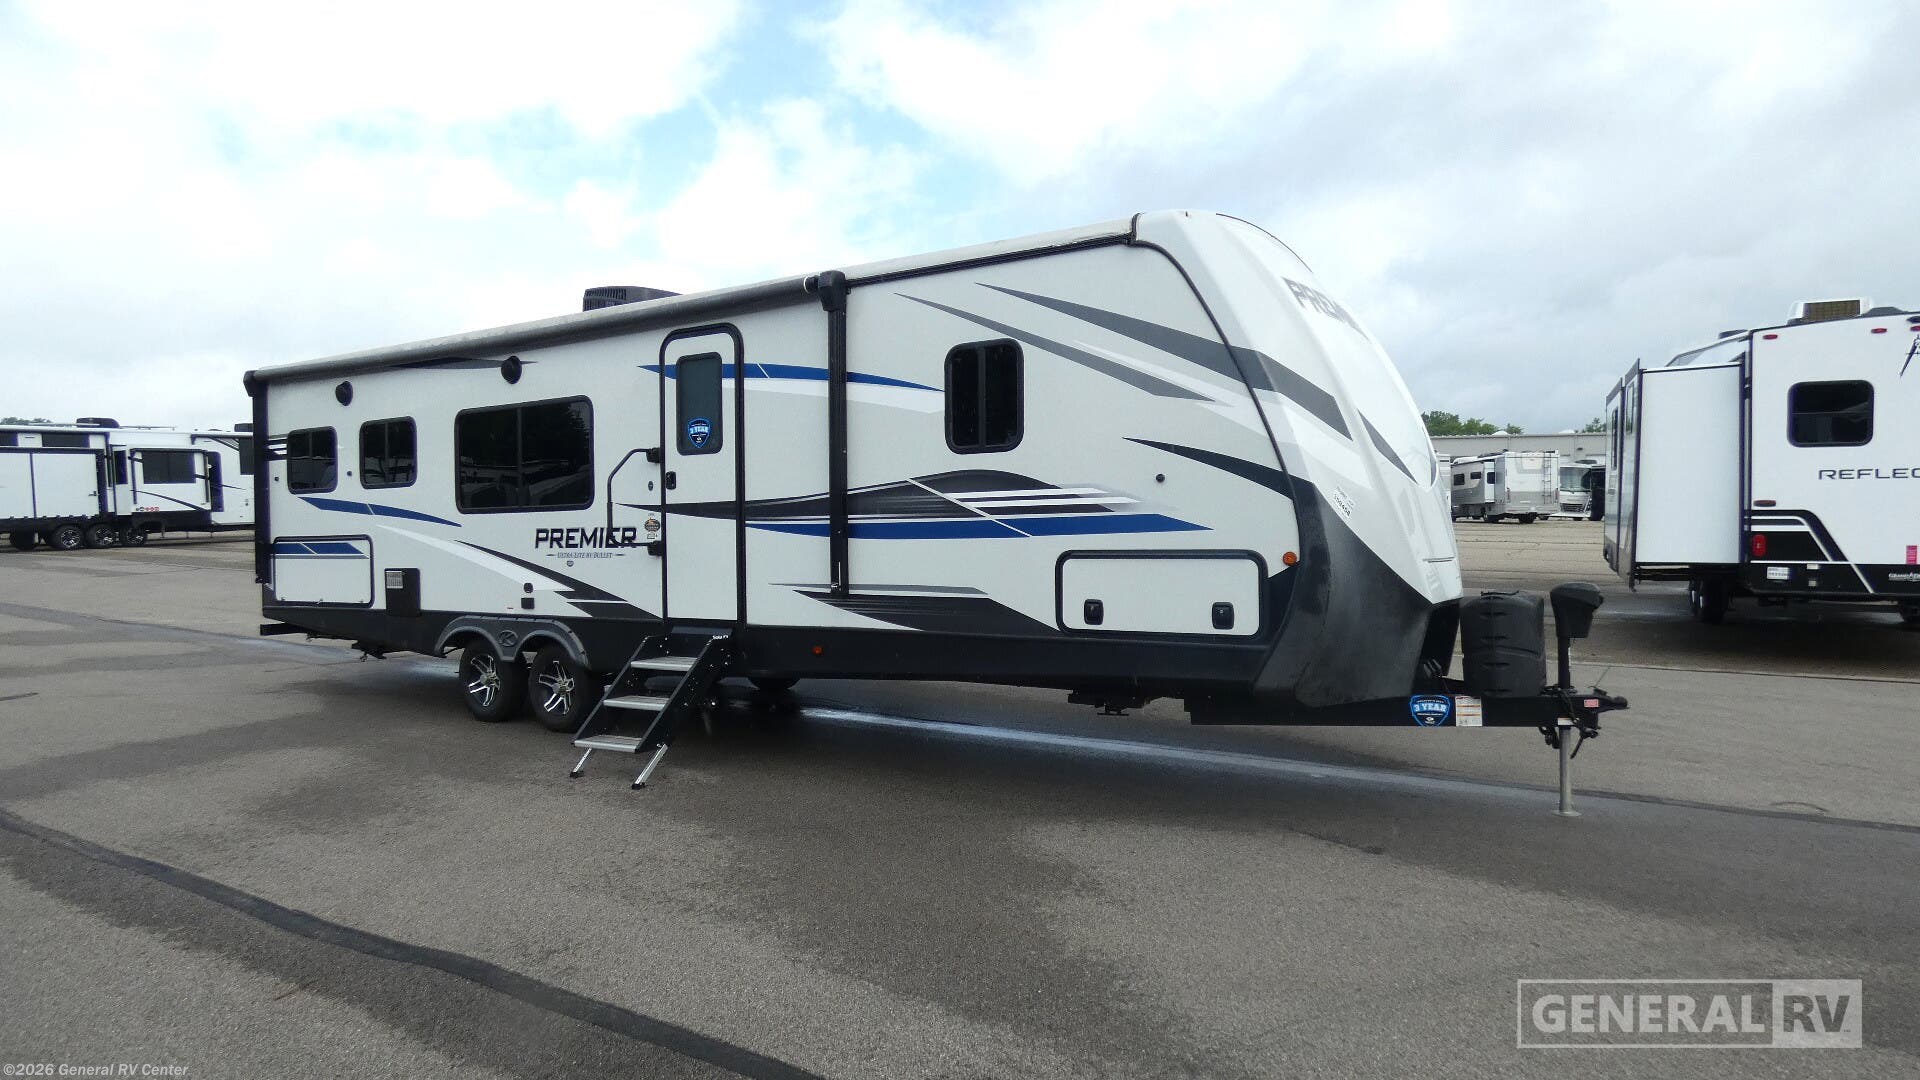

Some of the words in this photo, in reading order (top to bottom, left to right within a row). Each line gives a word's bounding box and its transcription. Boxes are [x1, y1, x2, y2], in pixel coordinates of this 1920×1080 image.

[535, 527, 637, 549] PREMIER
[1413, 704, 1420, 712] 3
[1422, 703, 1447, 712] YEAR
